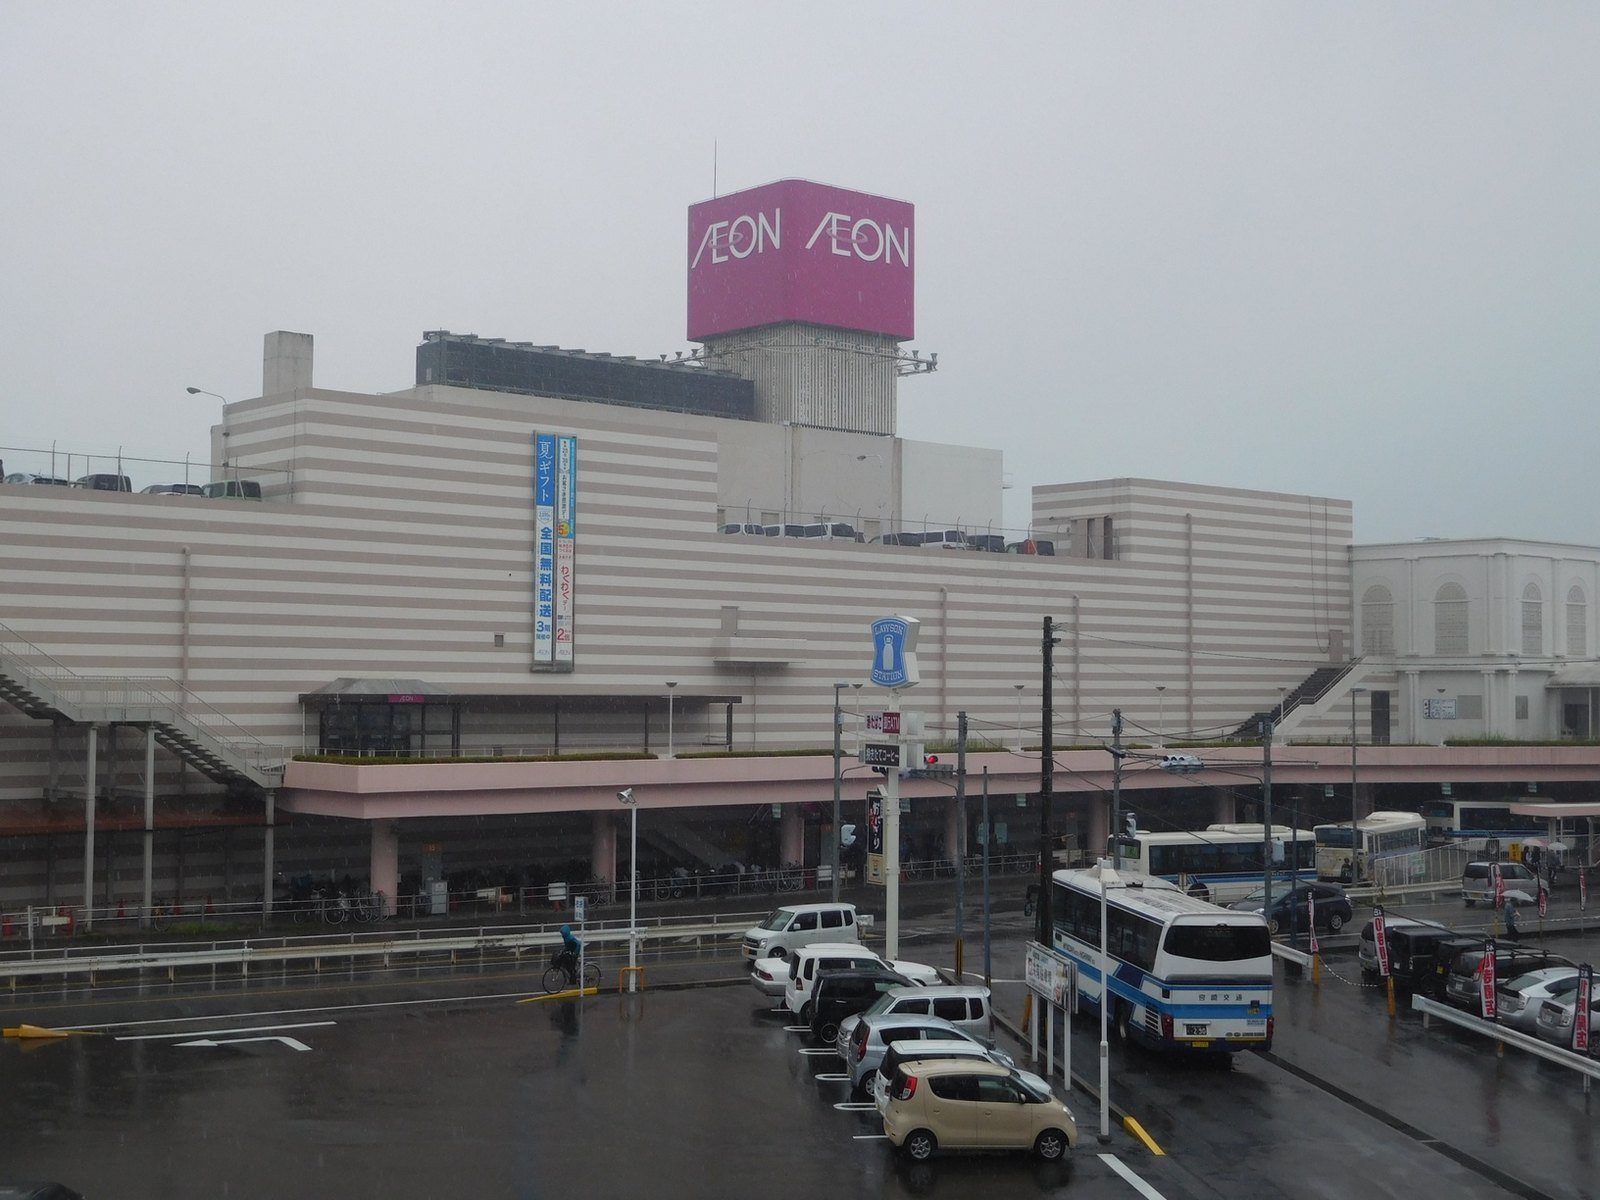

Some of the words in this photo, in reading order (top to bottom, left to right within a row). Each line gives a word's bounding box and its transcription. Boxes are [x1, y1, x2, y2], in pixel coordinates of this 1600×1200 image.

[539, 441, 553, 502] 夏ギフト
[539, 526, 553, 618] 全国無料配送
[874, 623, 904, 636] LAWSON
[873, 669, 903, 681] STATION
[1198, 993, 1243, 1001] 宮崎交通
